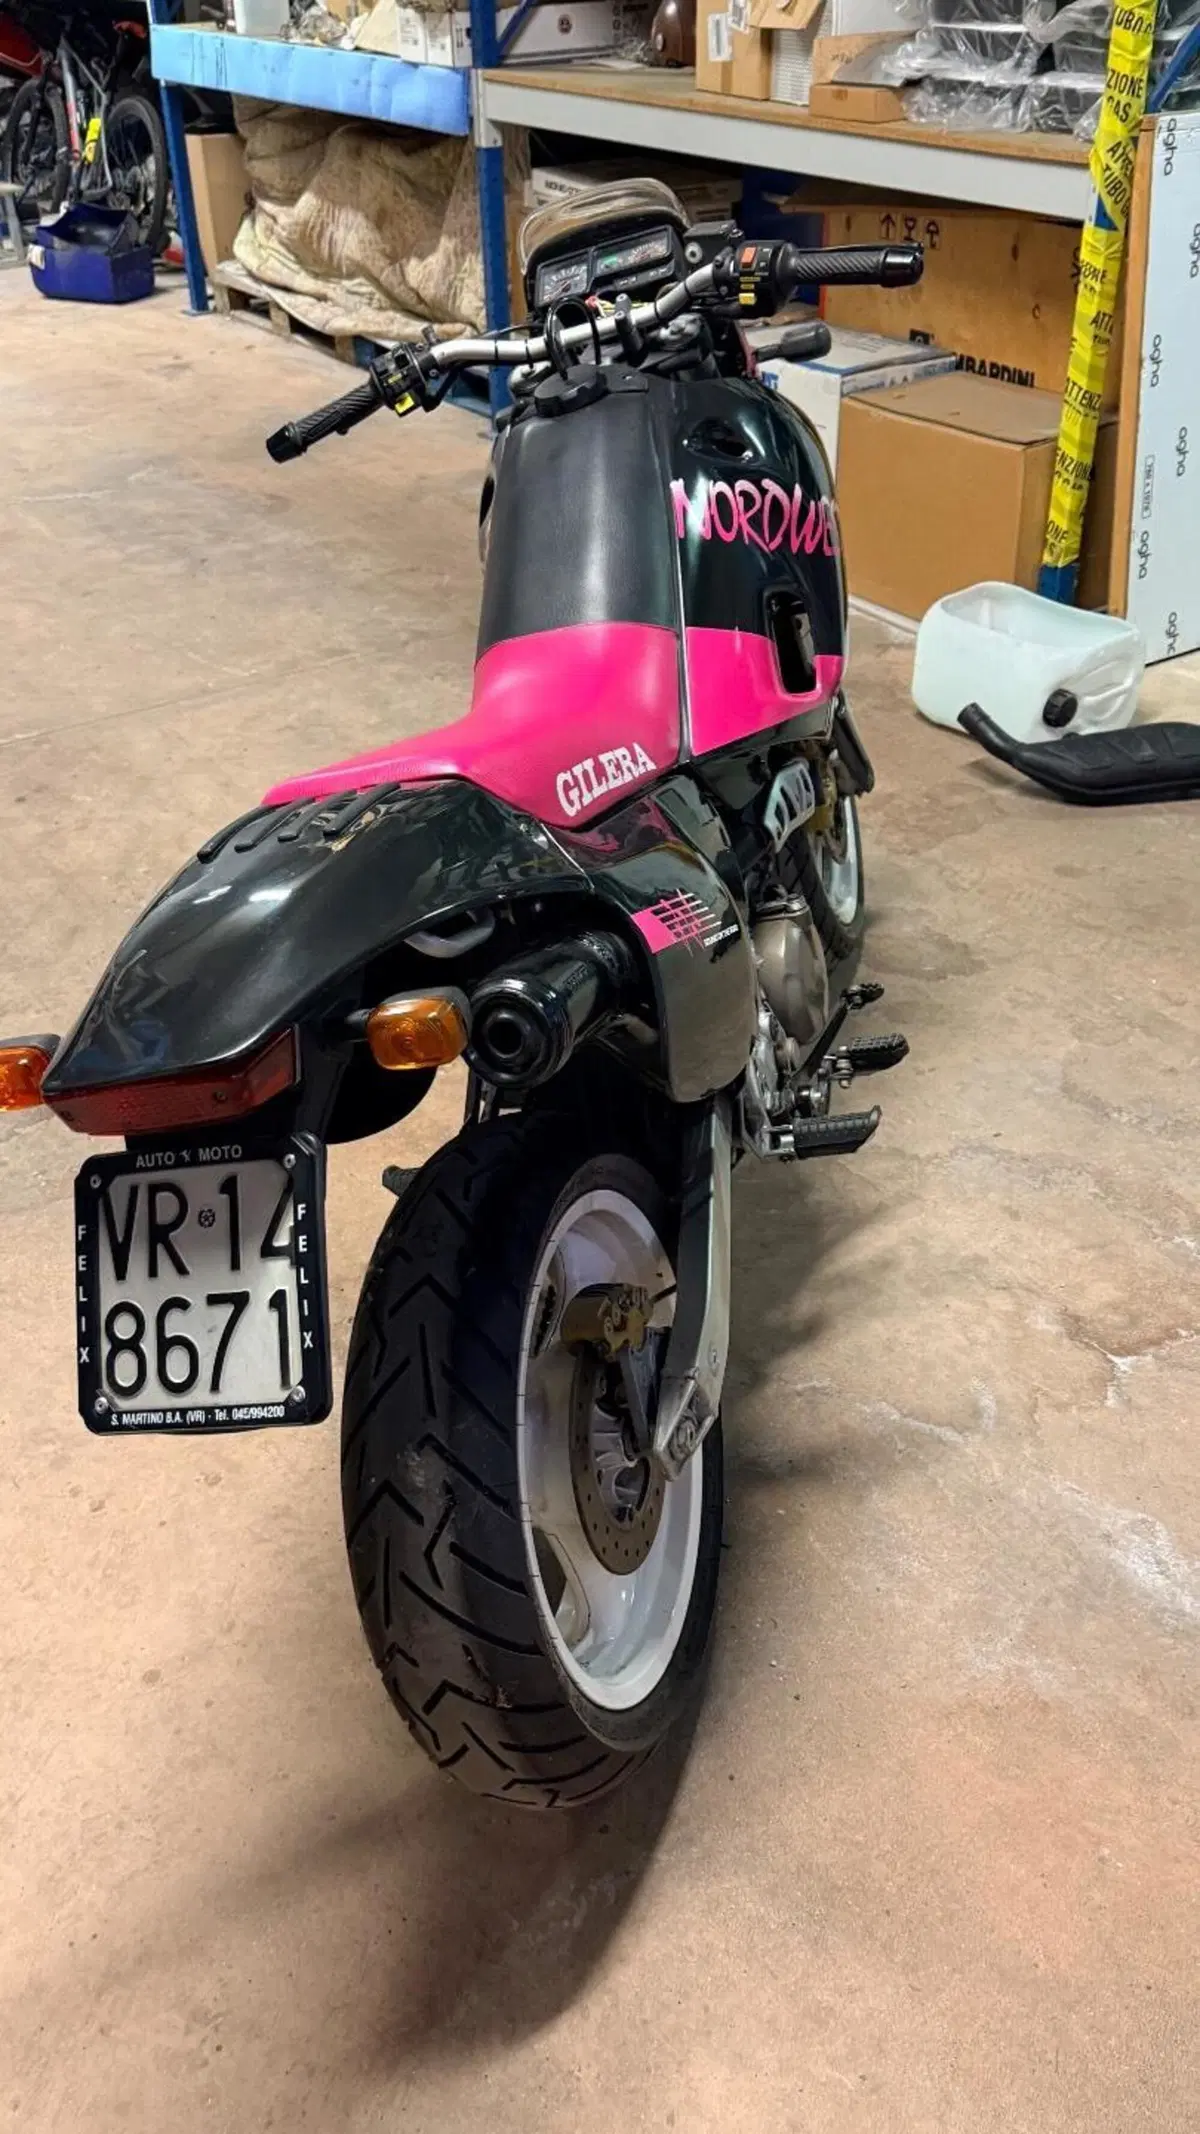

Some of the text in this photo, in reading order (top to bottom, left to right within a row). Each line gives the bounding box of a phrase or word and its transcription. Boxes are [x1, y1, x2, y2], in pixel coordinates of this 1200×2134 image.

[1106, 68, 1144, 98] ZIONE
[1163, 118, 1178, 176] agha
[1149, 334, 1163, 387] agha
[1176, 427, 1189, 477] agha
[1138, 530, 1152, 579] agha
[556, 741, 657, 817] GILERA
[136, 1145, 242, 1169] AUTO MOTO
[101, 1174, 297, 1281] VR 14
[77, 1225, 90, 1364] FELIX
[297, 1203, 314, 1348] FELIX
[105, 1289, 292, 1398] 8671
[111, 1415, 120, 1426] S.
[122, 1412, 164, 1425] MARTINO
[165, 1411, 183, 1424] B.A.
[186, 1410, 205, 1425] (VR)
[213, 1409, 229, 1421] Tel.
[232, 1405, 285, 1421] 045/994200
